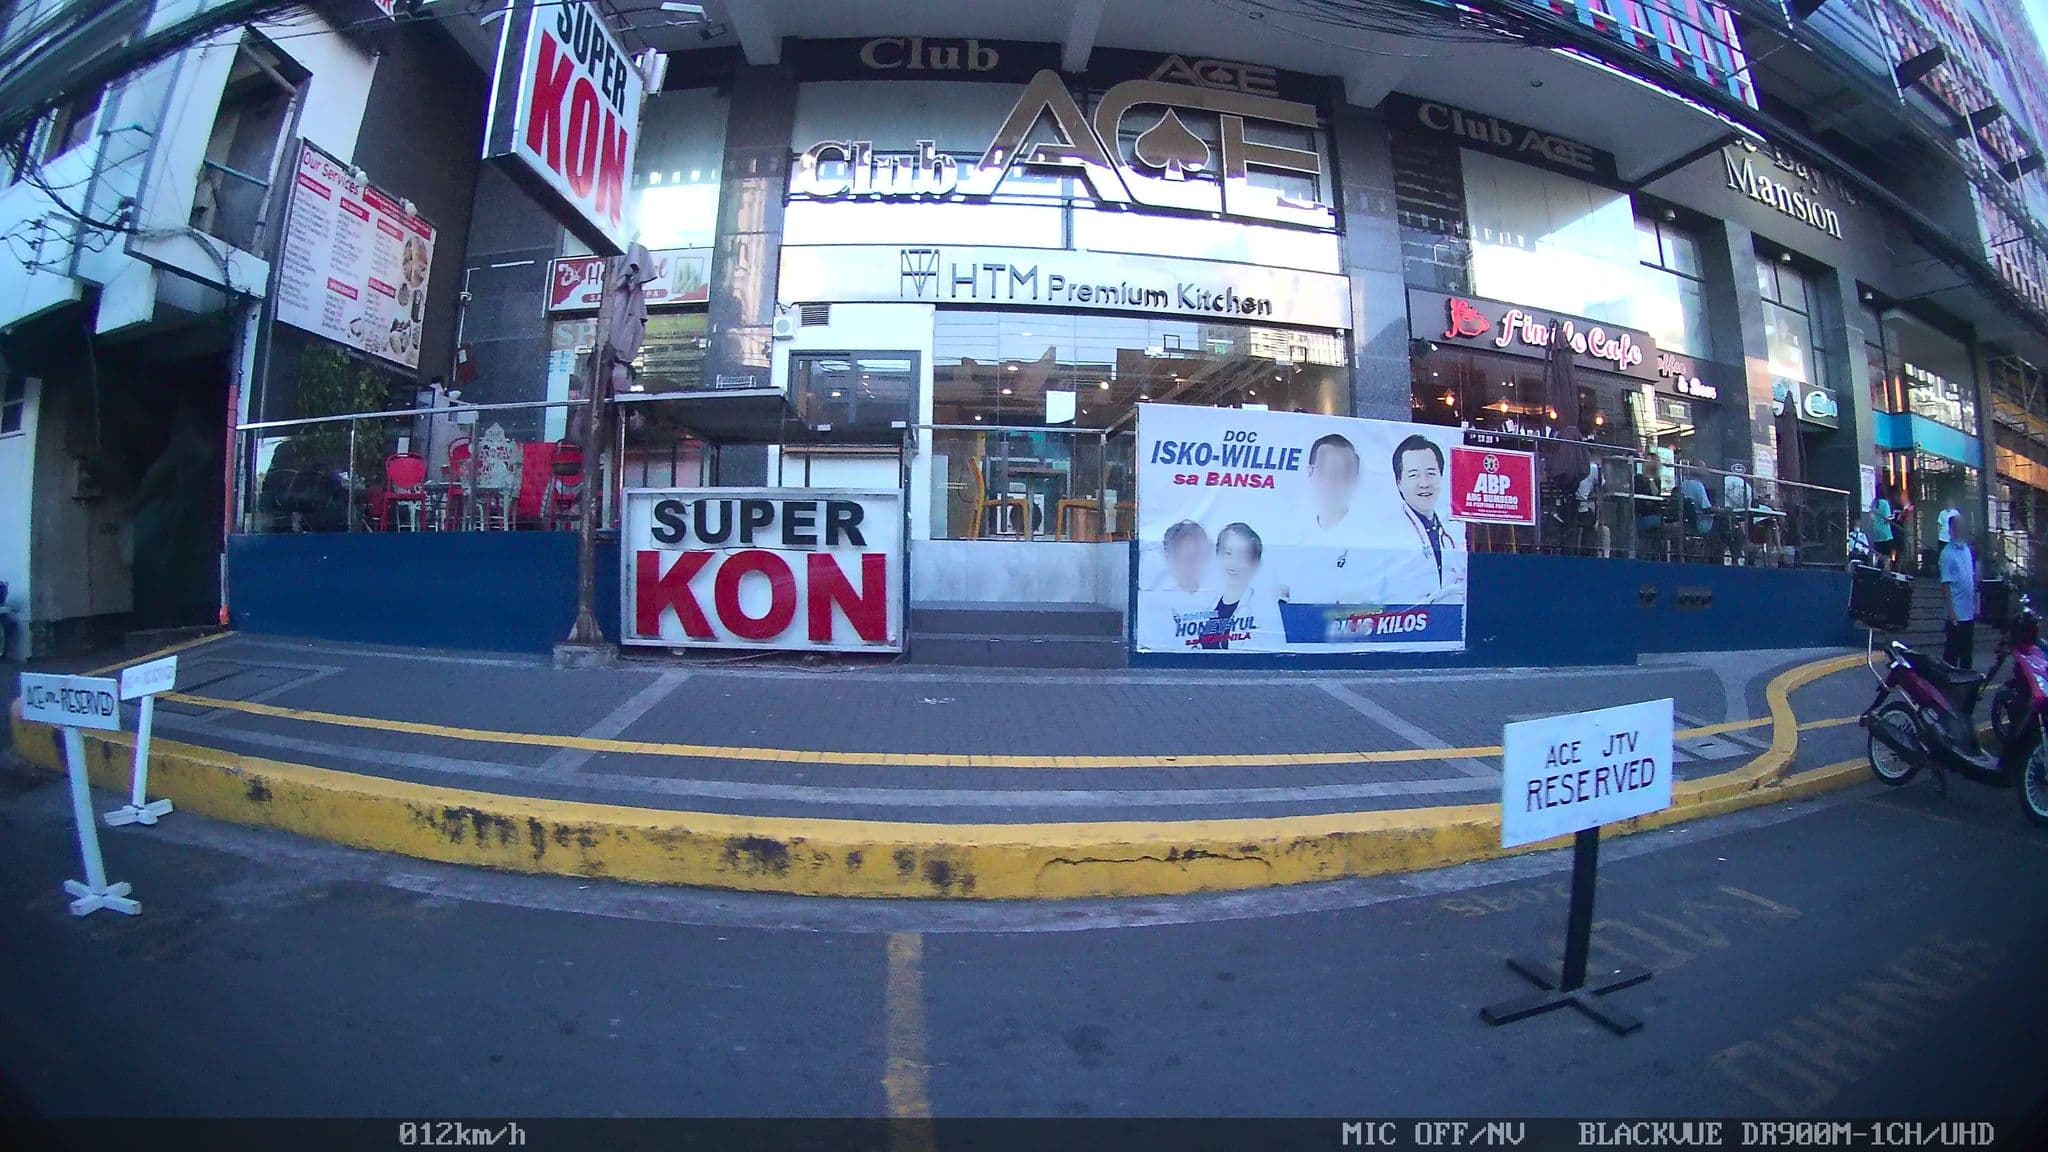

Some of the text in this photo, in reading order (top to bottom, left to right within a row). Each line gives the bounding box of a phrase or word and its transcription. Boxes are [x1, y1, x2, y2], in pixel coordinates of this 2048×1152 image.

[557, 0, 628, 117] SUPER
[860, 37, 999, 71] Club
[526, 28, 629, 229] KON
[1418, 103, 1512, 146] Club
[800, 69, 1336, 230] Club ACE
[303, 151, 321, 171] Our
[322, 163, 360, 195] Services
[1722, 147, 1842, 240] Mansion
[951, 263, 1273, 316] HTM Premium Kitchen
[1151, 440, 1302, 471] ISKO-WILLIE
[1223, 430, 1257, 443] DOC
[1173, 472, 1275, 489] sa BANSA
[1473, 473, 1511, 495] ABP
[651, 499, 867, 547] SUPER
[636, 549, 888, 642] KON
[1376, 613, 1428, 635] KILOS
[1545, 730, 1639, 769] ACE JTV
[1526, 757, 1655, 812] RESERVED
